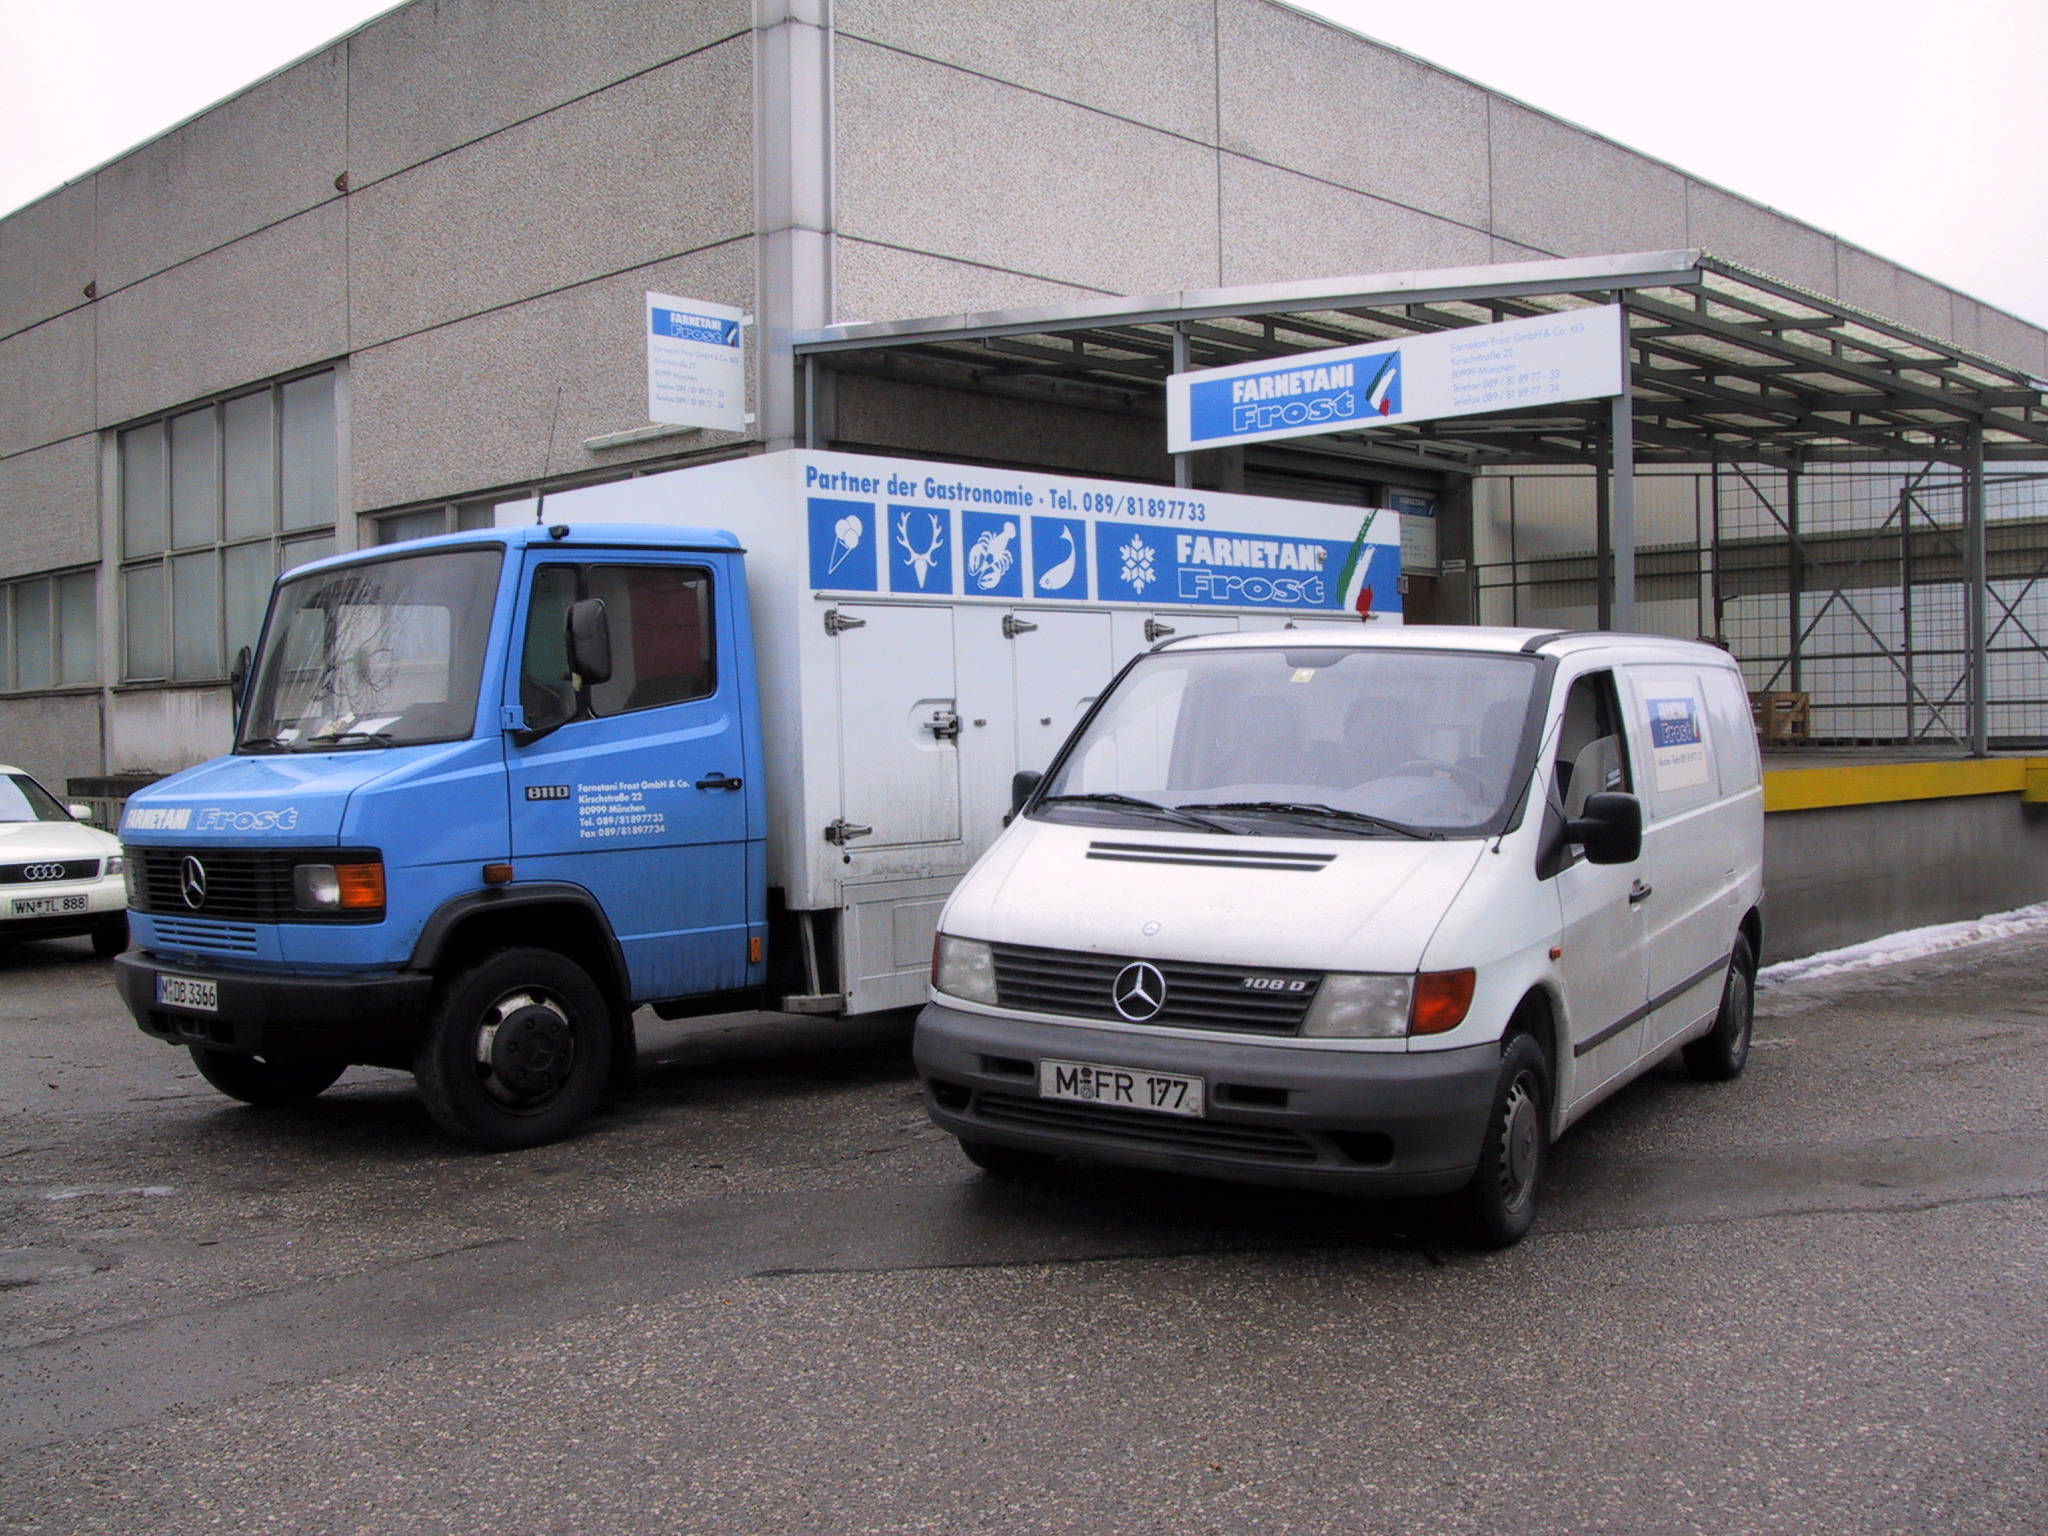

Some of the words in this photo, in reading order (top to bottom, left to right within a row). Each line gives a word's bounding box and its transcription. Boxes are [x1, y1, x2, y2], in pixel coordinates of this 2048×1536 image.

[670, 312, 722, 331] FARNETANI
[670, 324, 722, 342] Frost
[1512, 329, 1542, 343] GmbH
[1543, 328, 1551, 338] &
[1570, 322, 1585, 333] KG
[1502, 347, 1514, 359] 22
[1232, 362, 1355, 404] FARNETANI
[1481, 377, 1499, 389] 089
[1549, 368, 1561, 380] 33
[1481, 391, 1499, 403] 089
[1232, 389, 1355, 432] Frost
[806, 465, 880, 494] Partner
[887, 473, 918, 498] der
[924, 477, 1034, 507] Gastronomie
[1049, 488, 1078, 511] Tel.
[1083, 491, 1206, 522] 089/81897733
[1176, 534, 1325, 572] FARNETANI
[1178, 567, 1325, 604] Frost
[578, 782, 618, 793] Farnetani
[619, 781, 640, 791] Frost
[641, 780, 667, 790] GmbH
[668, 779, 676, 788] &
[677, 779, 691, 788] Co.
[579, 792, 630, 804] Kirschstraße
[631, 792, 643, 802] 22
[125, 809, 192, 830] FARNETANI
[197, 806, 298, 831] Frost
[579, 806, 607, 816] 80999
[609, 804, 646, 814] München
[580, 817, 595, 827] Tel.
[596, 813, 664, 826] 089/81897733
[580, 829, 596, 839] Fax
[597, 825, 666, 838] 089/81897734
[62, 898, 86, 910] 888
[1243, 978, 1285, 991] 108
[1288, 980, 1305, 992] D
[188, 982, 217, 1008] 3366
[1147, 1077, 1189, 1109] 177
